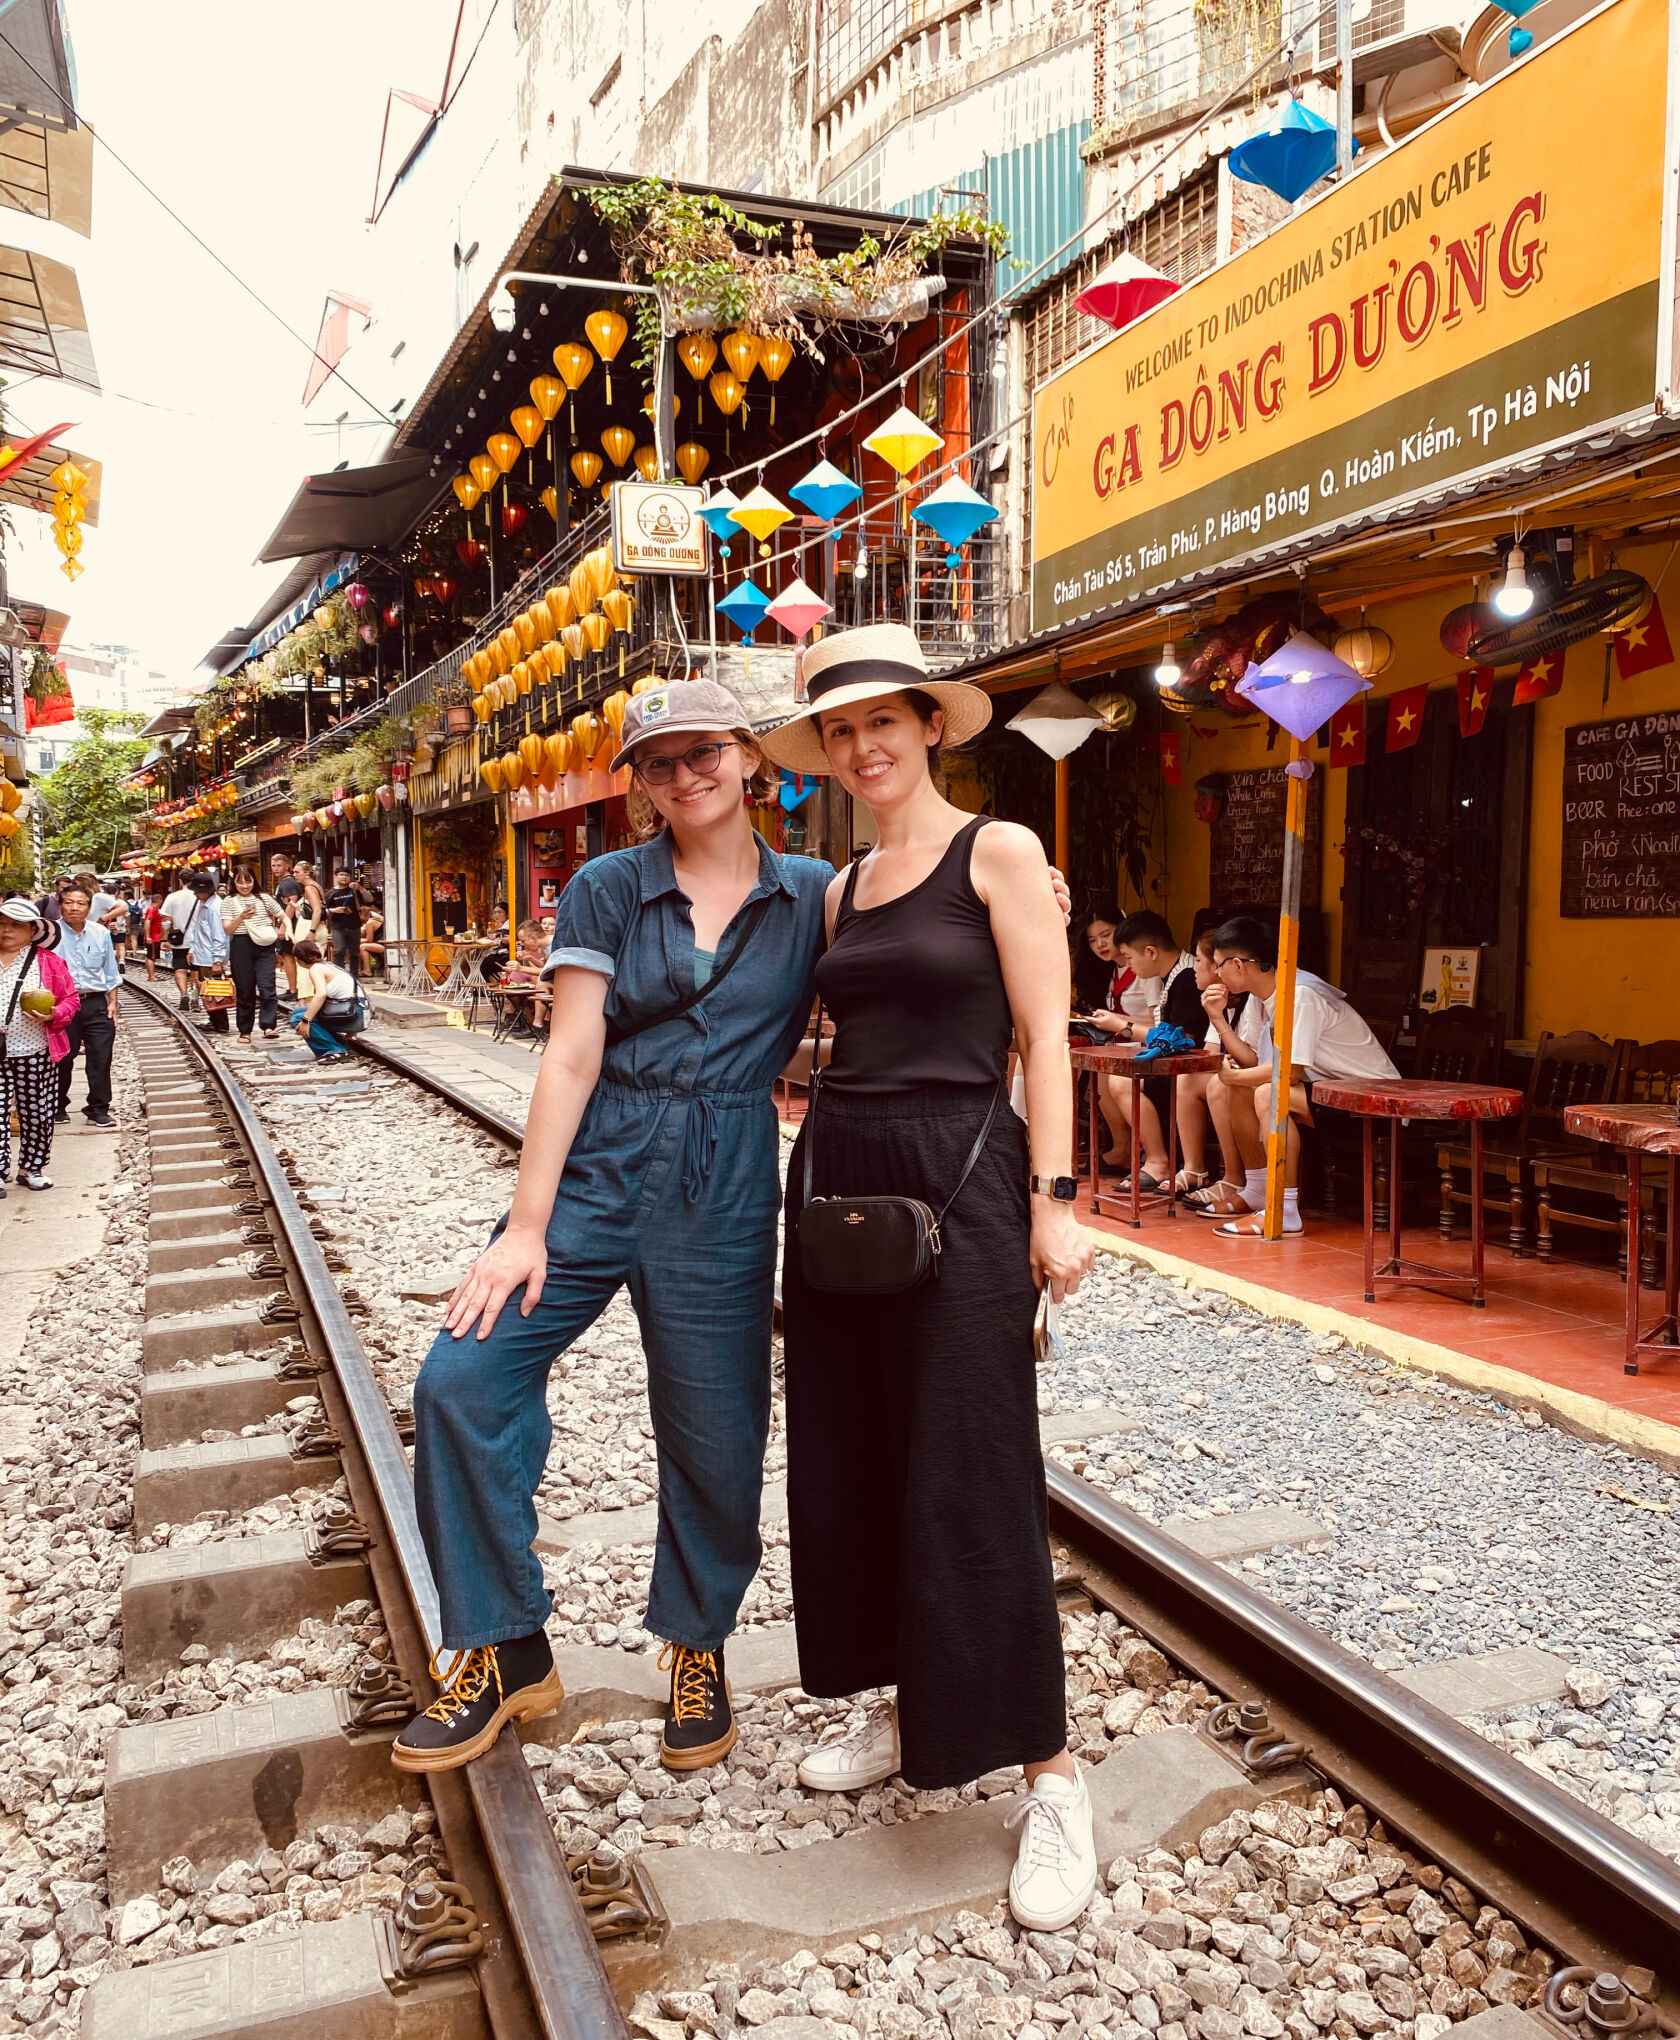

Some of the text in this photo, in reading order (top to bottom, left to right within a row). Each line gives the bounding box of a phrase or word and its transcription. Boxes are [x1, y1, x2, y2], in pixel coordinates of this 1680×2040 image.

[1125, 140, 1493, 394] WELCOME TO INDOCHINA STATION CAFE
[1093, 190, 1547, 500] GA ĐÔNG DƯƠNG
[1083, 568, 1105, 594] Tàu
[1106, 554, 1123, 585] Số
[1125, 554, 1136, 577] 5,
[1138, 538, 1167, 571] Trần
[1171, 524, 1202, 559] Phú,
[1205, 518, 1217, 545] P.
[1220, 505, 1261, 534] Hàng
[1265, 484, 1310, 522] Bông
[1319, 468, 1339, 498] Q.
[1345, 448, 1395, 488] Hoàn
[1400, 417, 1462, 467] Kiếm,
[1467, 403, 1497, 446] Tp
[1504, 385, 1537, 425] Hà
[1545, 360, 1591, 409] Nội
[627, 545, 639, 556] GA
[1576, 727, 1611, 746] CAFE
[1614, 722, 1640, 740] GA
[1577, 762, 1614, 783] FOOD
[1619, 774, 1664, 798] REST
[1581, 829, 1620, 872] phở
[1585, 863, 1661, 888] bún chả
[1584, 895, 1620, 911] nem
